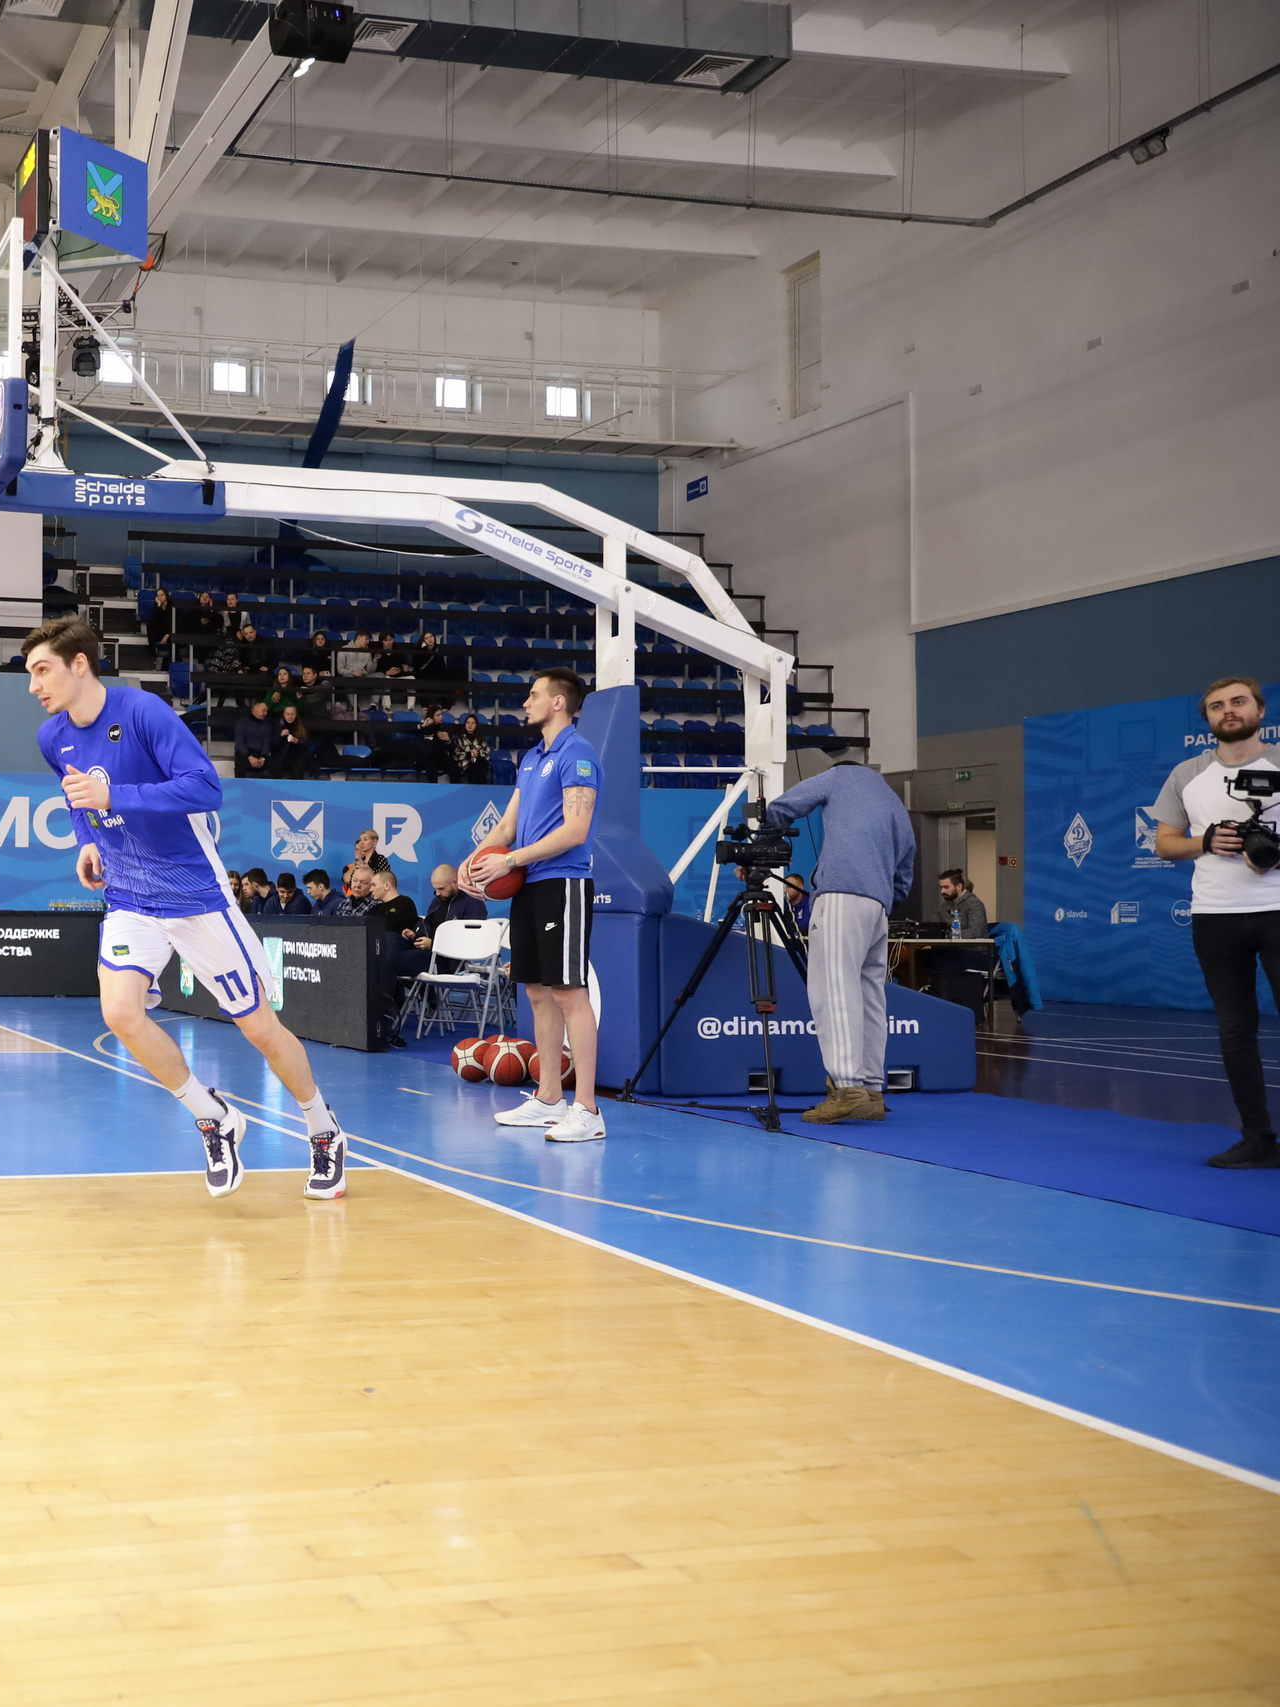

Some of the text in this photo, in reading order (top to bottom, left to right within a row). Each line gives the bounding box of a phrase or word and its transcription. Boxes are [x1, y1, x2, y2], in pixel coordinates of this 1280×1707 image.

[75, 478, 146, 495] Schelde
[74, 490, 146, 507] Sports
[484, 522, 593, 579] Schelde Sports
[102, 814, 126, 829] КРАЙ
[1066, 910, 1088, 918] slavda
[283, 941, 337, 958] ПРИ ПОДДЕРЖКЕ
[213, 969, 249, 1001] 11
